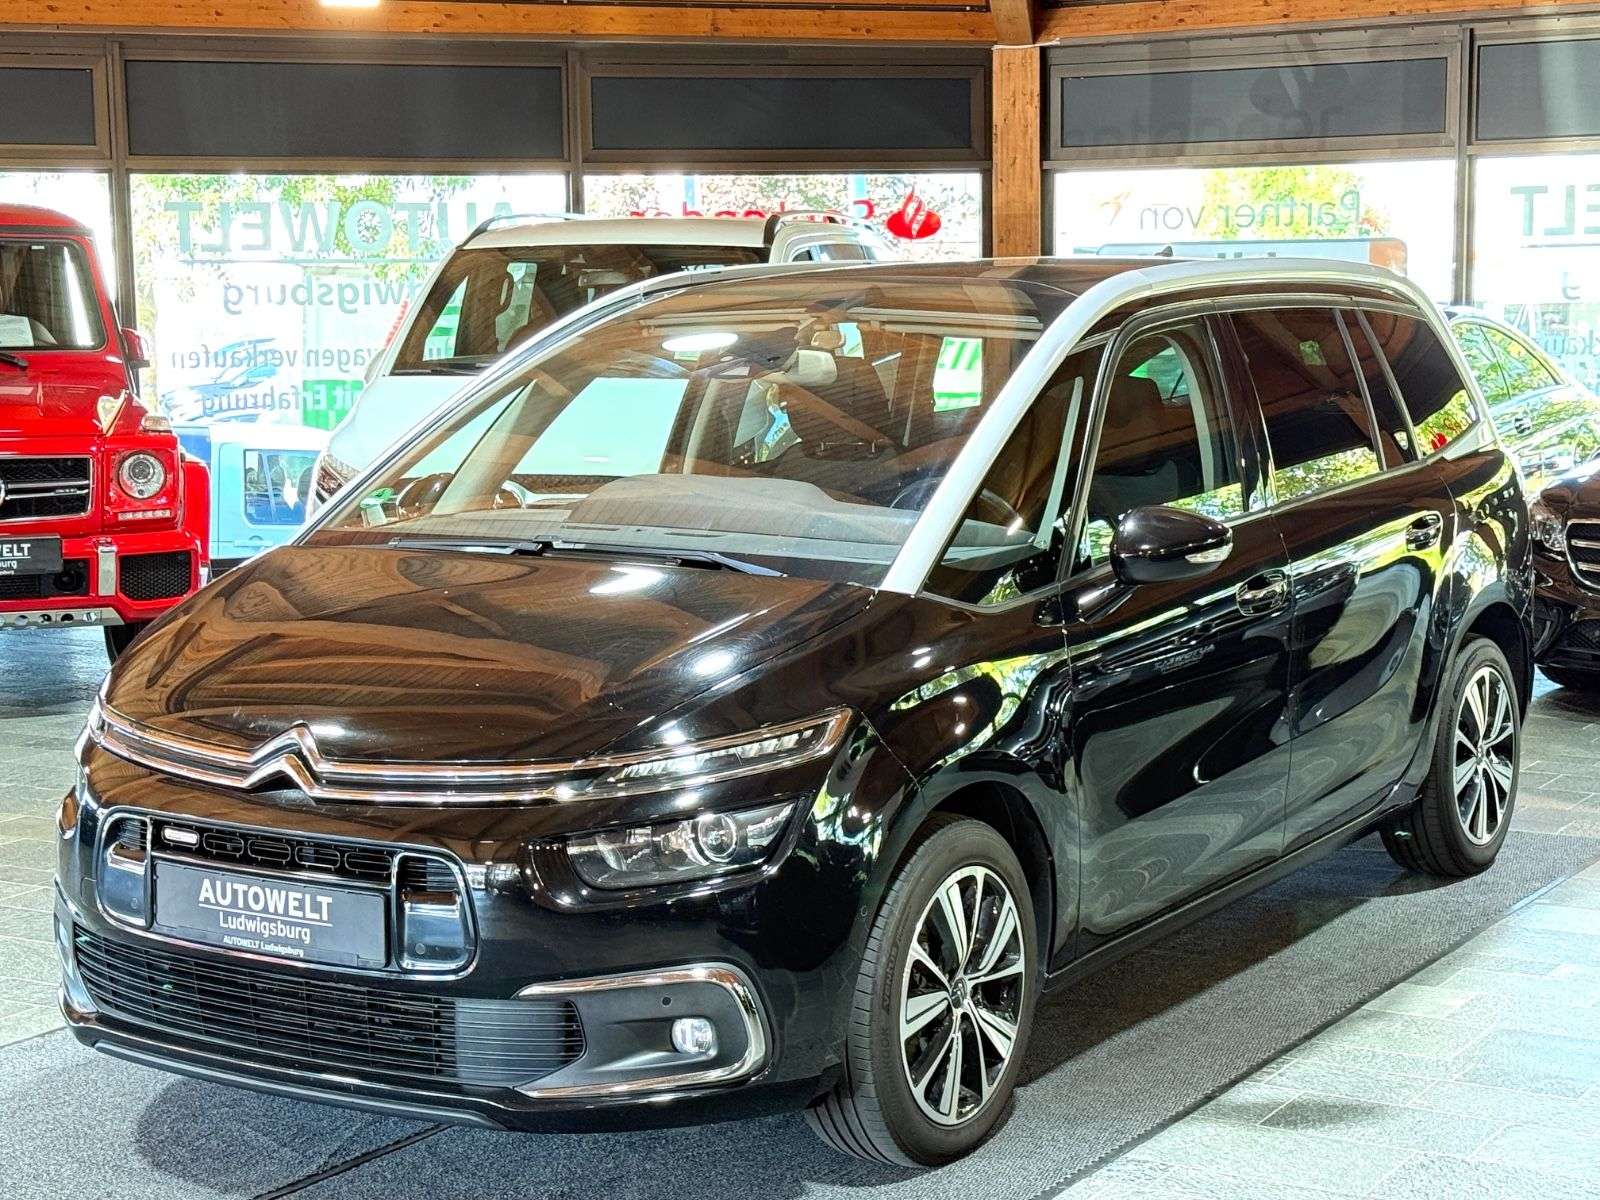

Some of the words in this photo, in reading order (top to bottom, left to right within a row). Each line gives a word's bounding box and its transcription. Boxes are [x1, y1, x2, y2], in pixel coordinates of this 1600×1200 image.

[199, 878, 333, 921] AUTOWELT
[219, 911, 311, 944] Ludwigsburg
[223, 935, 260, 949] AUTOWELT
[260, 941, 304, 958] Ludwigsburg
